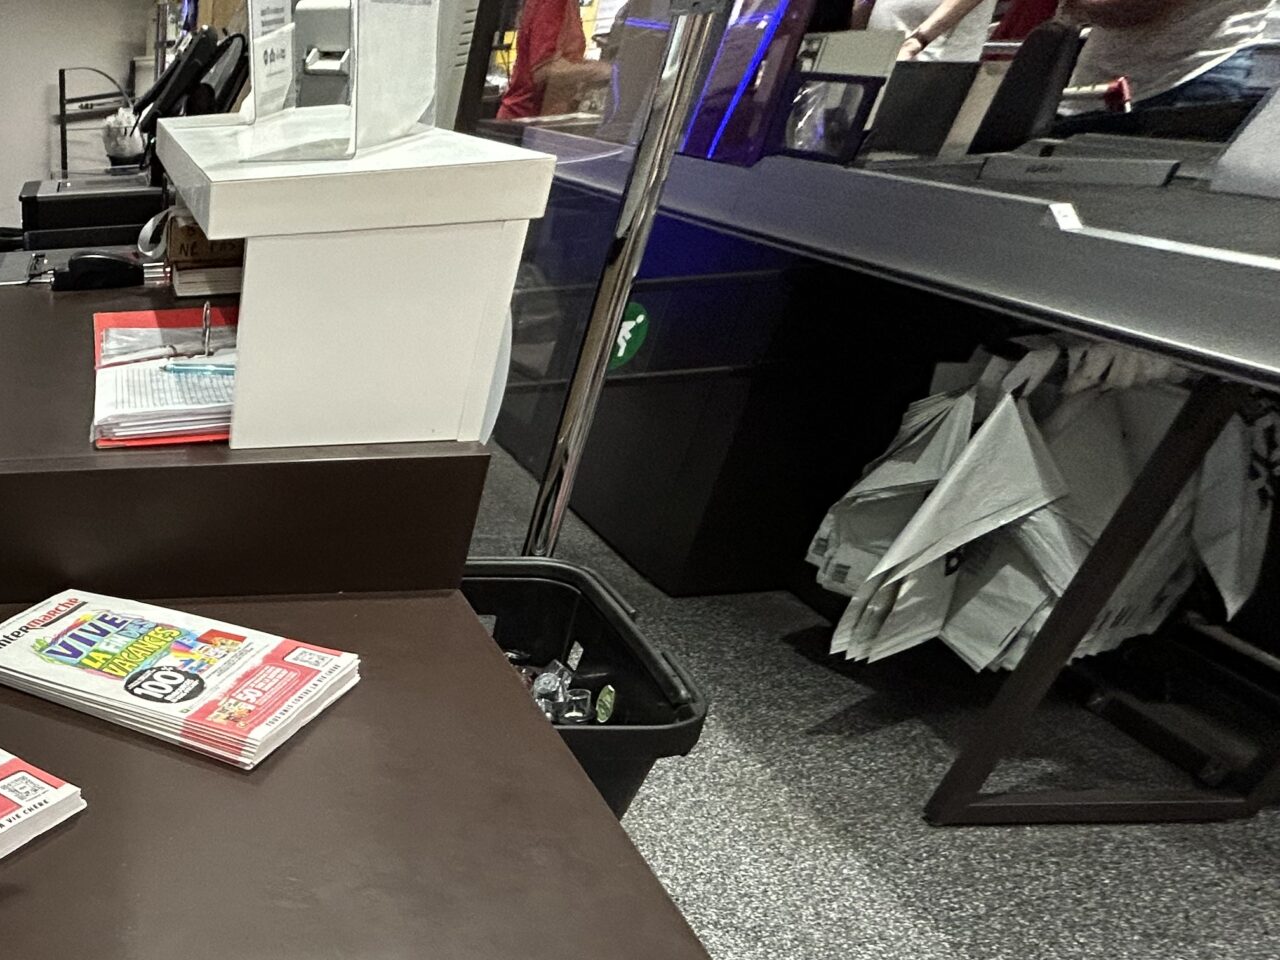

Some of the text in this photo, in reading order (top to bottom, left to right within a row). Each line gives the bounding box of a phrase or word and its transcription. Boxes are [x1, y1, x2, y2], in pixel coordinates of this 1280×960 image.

[45, 612, 129, 661] VIVE
[101, 626, 182, 677] VACANCES
[81, 650, 114, 669] LA
[6, 813, 22, 824] VIE
